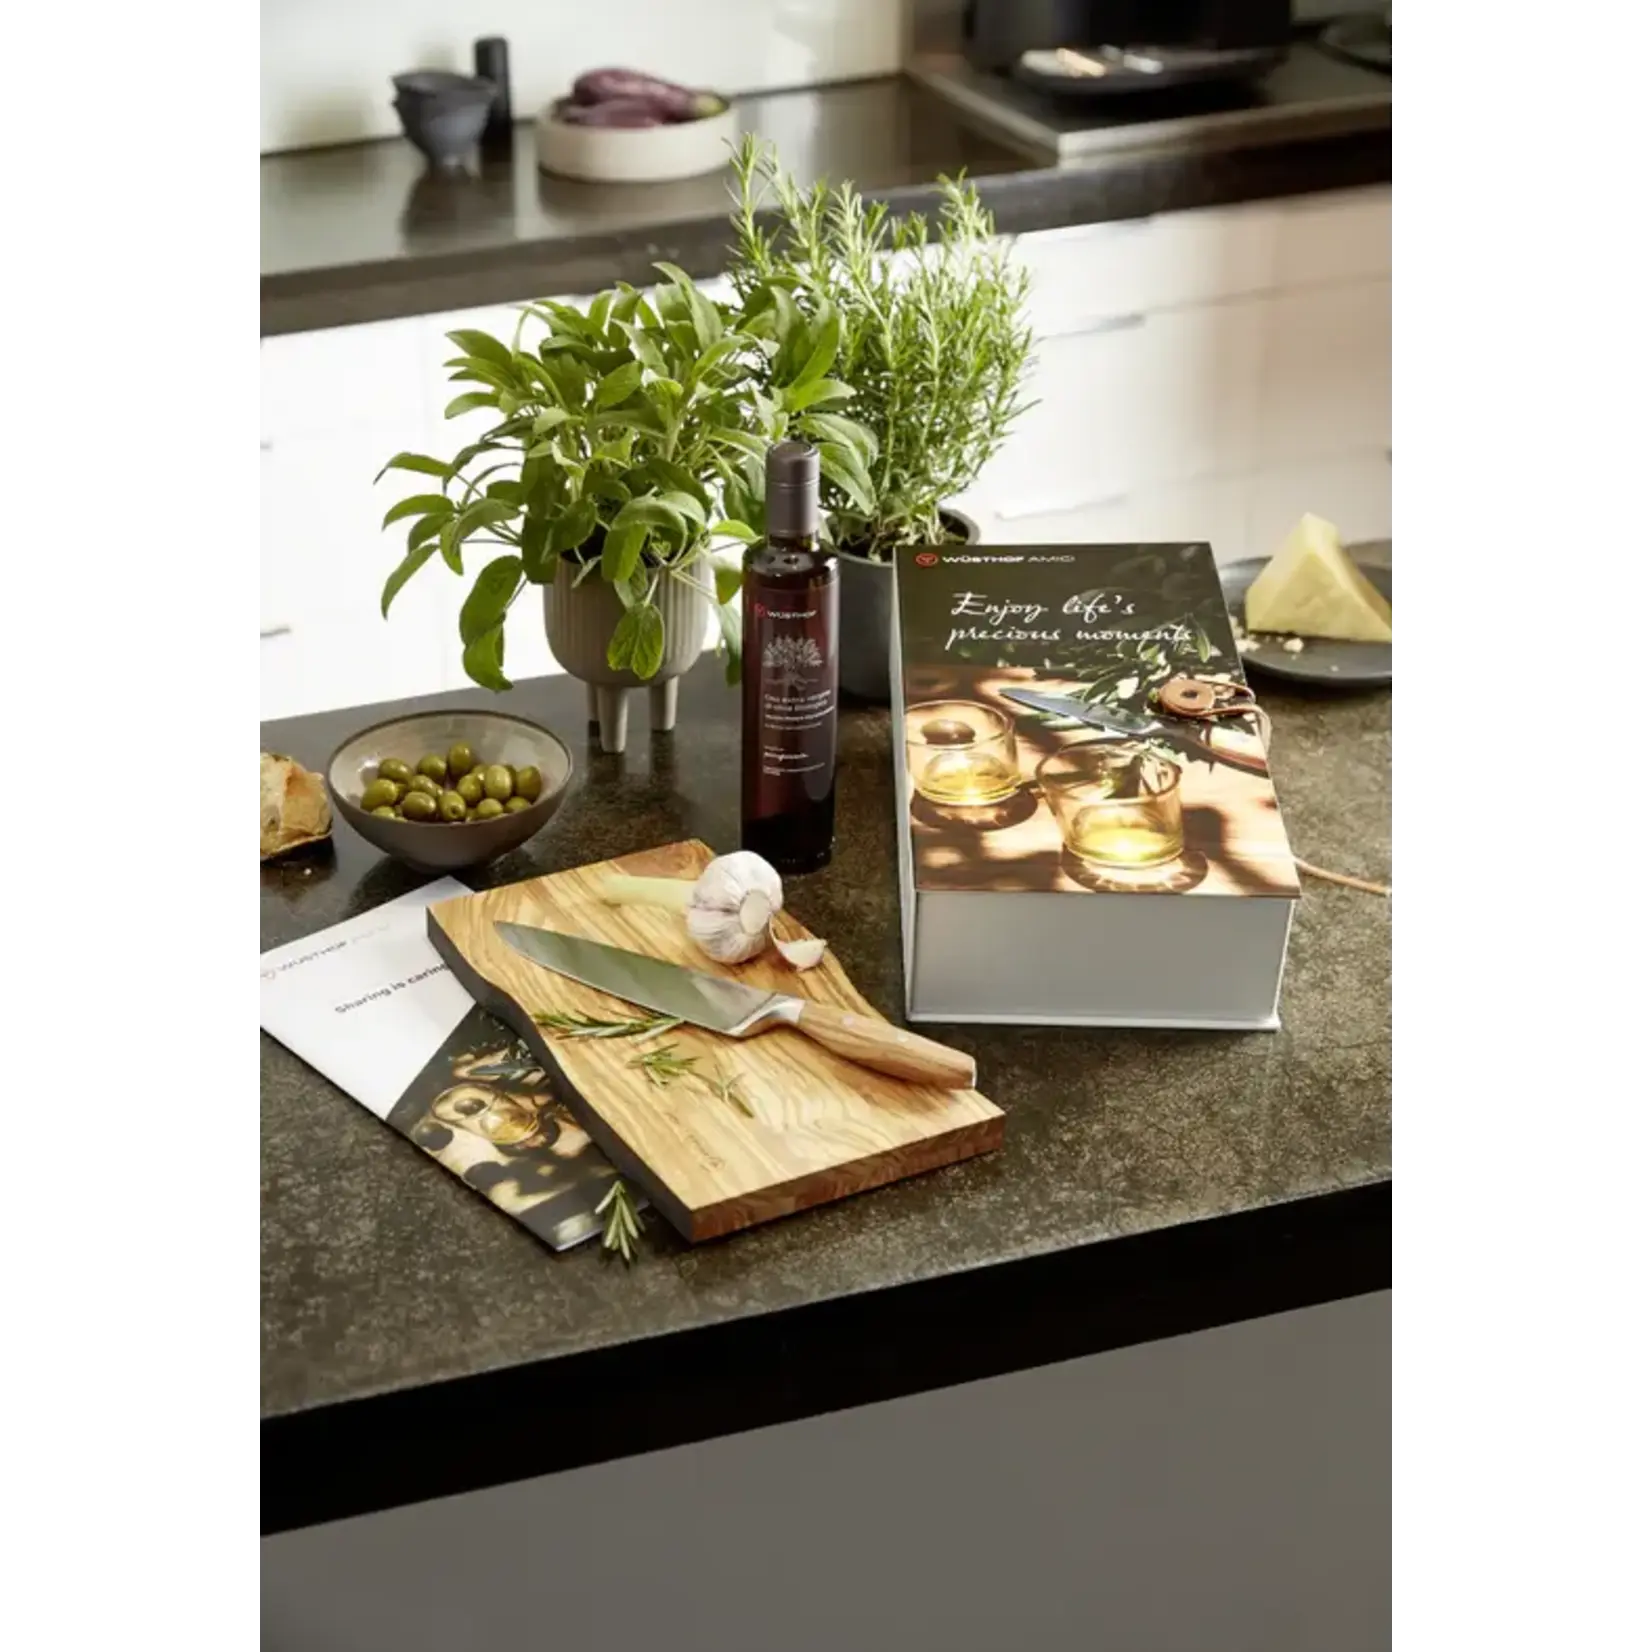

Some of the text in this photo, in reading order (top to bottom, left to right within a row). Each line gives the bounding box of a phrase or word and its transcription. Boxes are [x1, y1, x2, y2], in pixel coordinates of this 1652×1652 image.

[950, 591, 1136, 624] Enjoy life's
[944, 624, 1193, 650] precious moments
[334, 987, 392, 1014] Sharing
[389, 980, 407, 992] is
